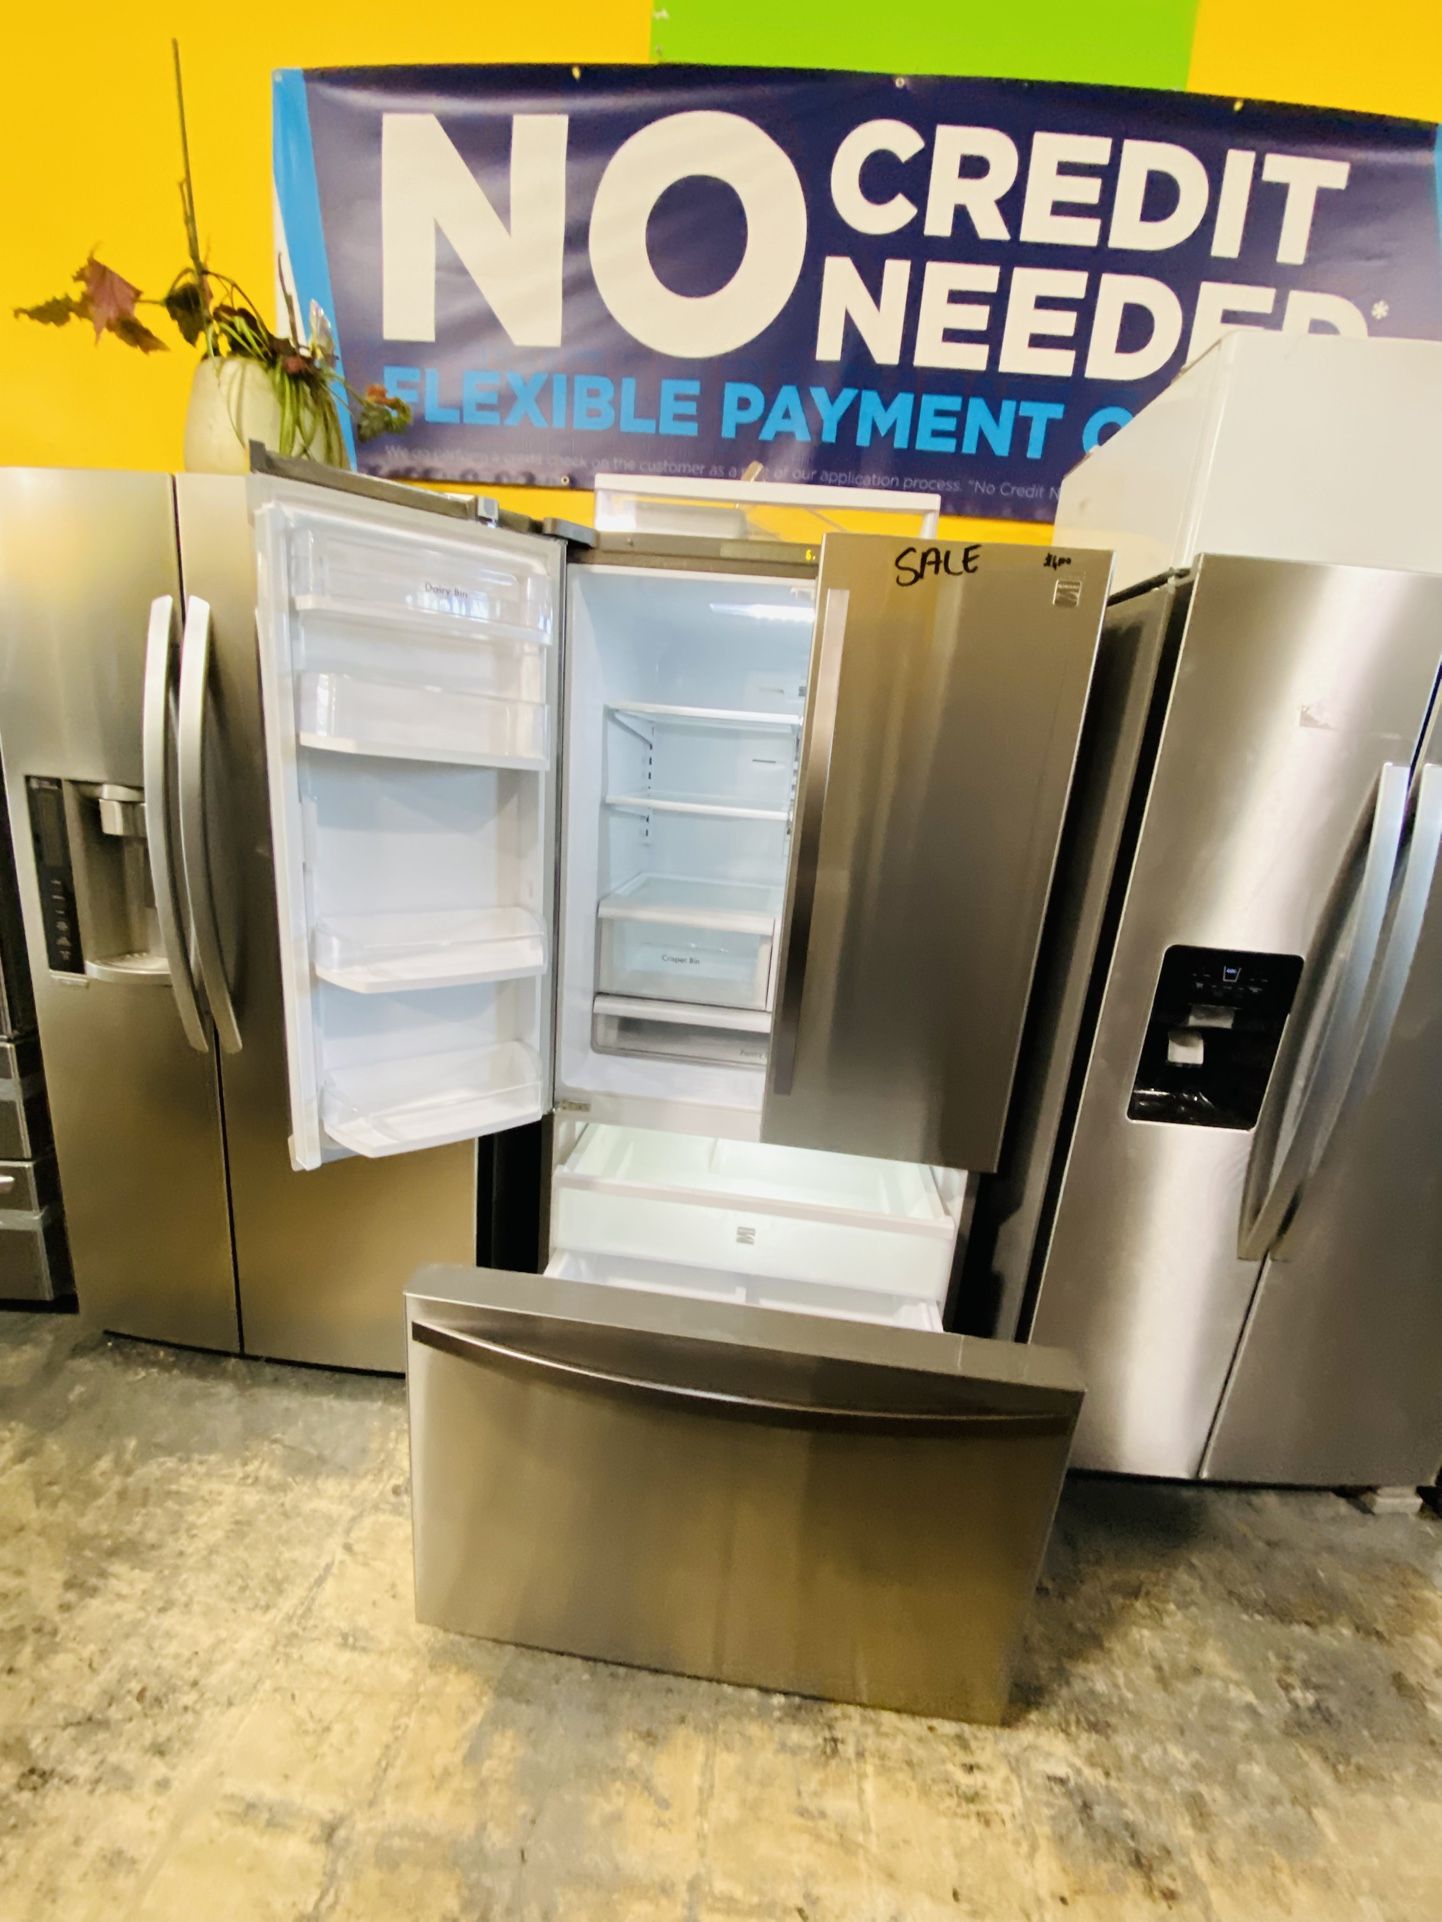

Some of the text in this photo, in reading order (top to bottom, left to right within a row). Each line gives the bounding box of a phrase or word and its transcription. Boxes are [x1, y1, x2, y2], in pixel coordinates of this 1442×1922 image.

[830, 119, 1351, 265] CREDIT
[381, 111, 808, 359] NO
[383, 366, 699, 436] FLEXIBLE
[721, 382, 1065, 460] PAYMENT
[613, 456, 636, 471] the
[639, 460, 704, 475] customer
[709, 464, 725, 477] as
[728, 465, 737, 477] a
[774, 464, 789, 479] of
[792, 468, 817, 481] our
[819, 469, 900, 488] application
[902, 476, 962, 492] process.
[1000, 481, 1045, 499] Credit
[895, 544, 982, 587] SALE
